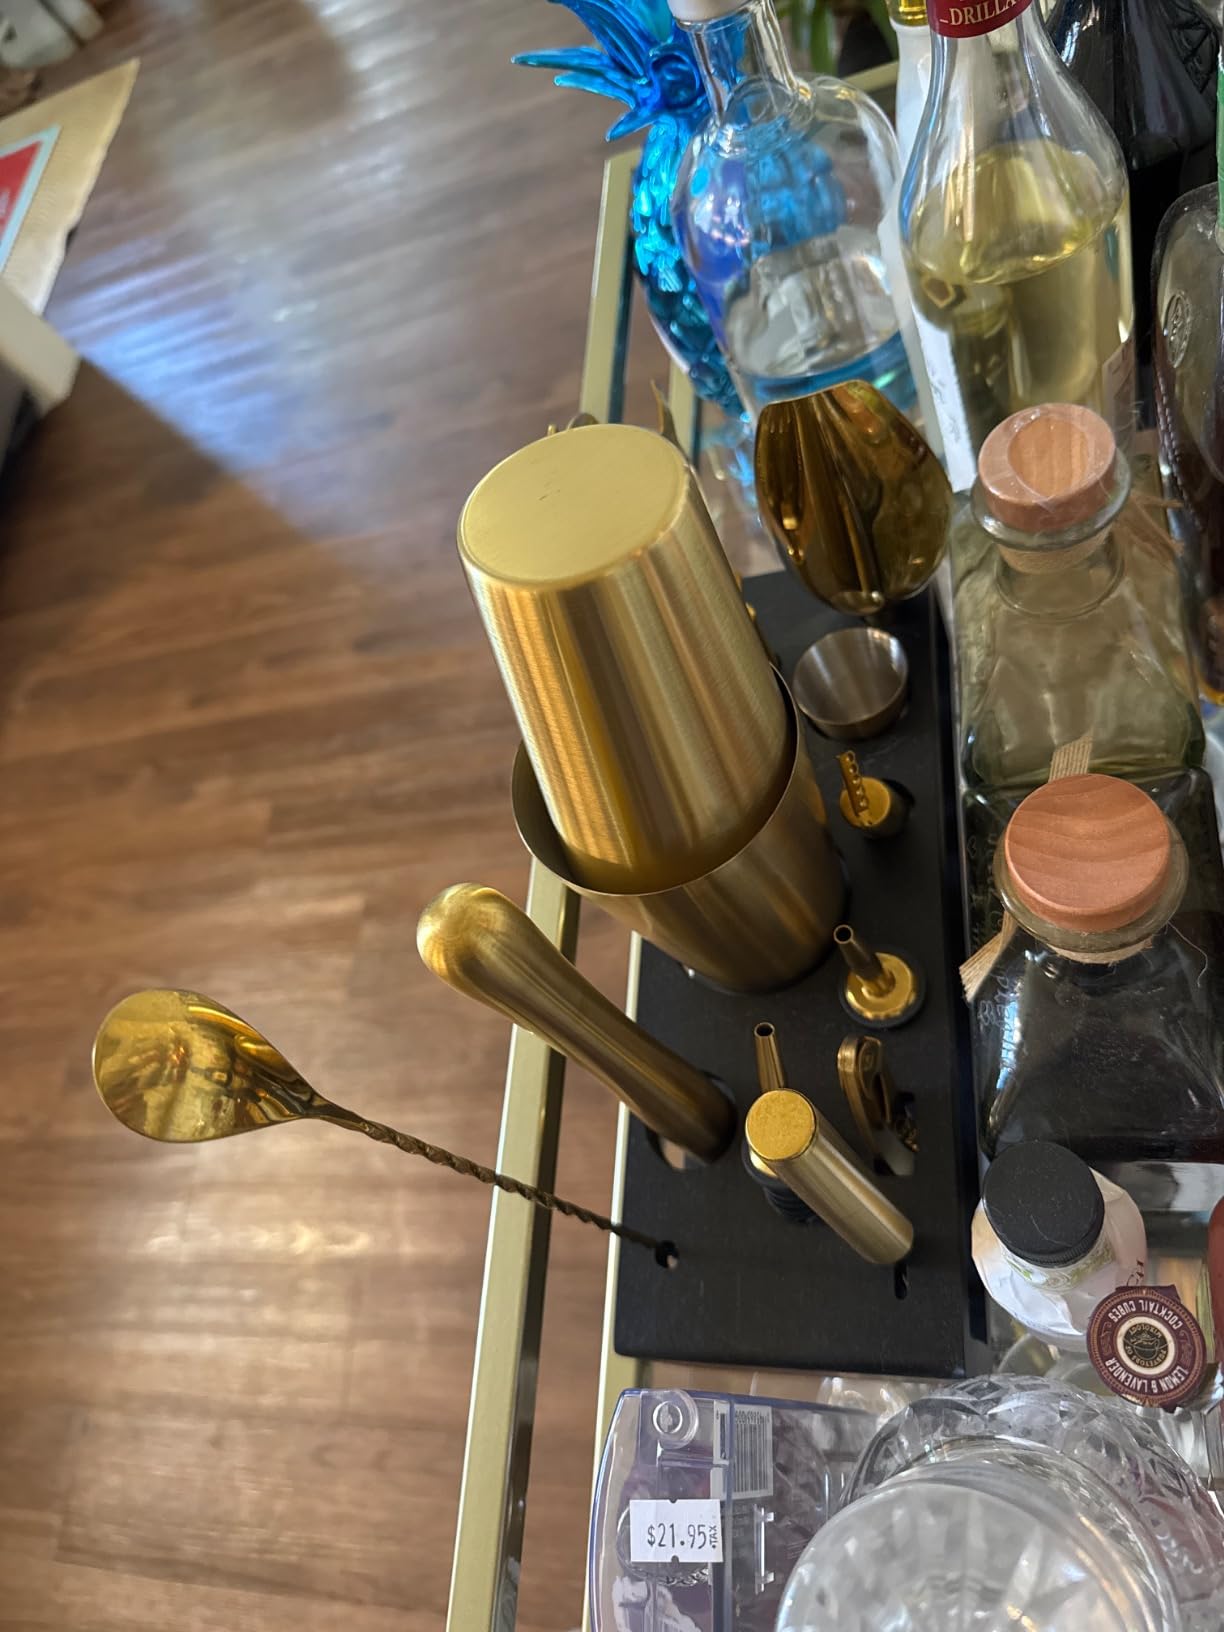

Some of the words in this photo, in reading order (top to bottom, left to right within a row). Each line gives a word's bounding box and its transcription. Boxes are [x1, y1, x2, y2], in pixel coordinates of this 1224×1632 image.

[1107, 1300, 1137, 1323] CUBES
[1139, 1299, 1183, 1330] COCKTAIL
[1105, 1357, 1148, 1393] LAVENDER
[1160, 1365, 1188, 1392] LEMON
[647, 1522, 707, 1549] $21.95
